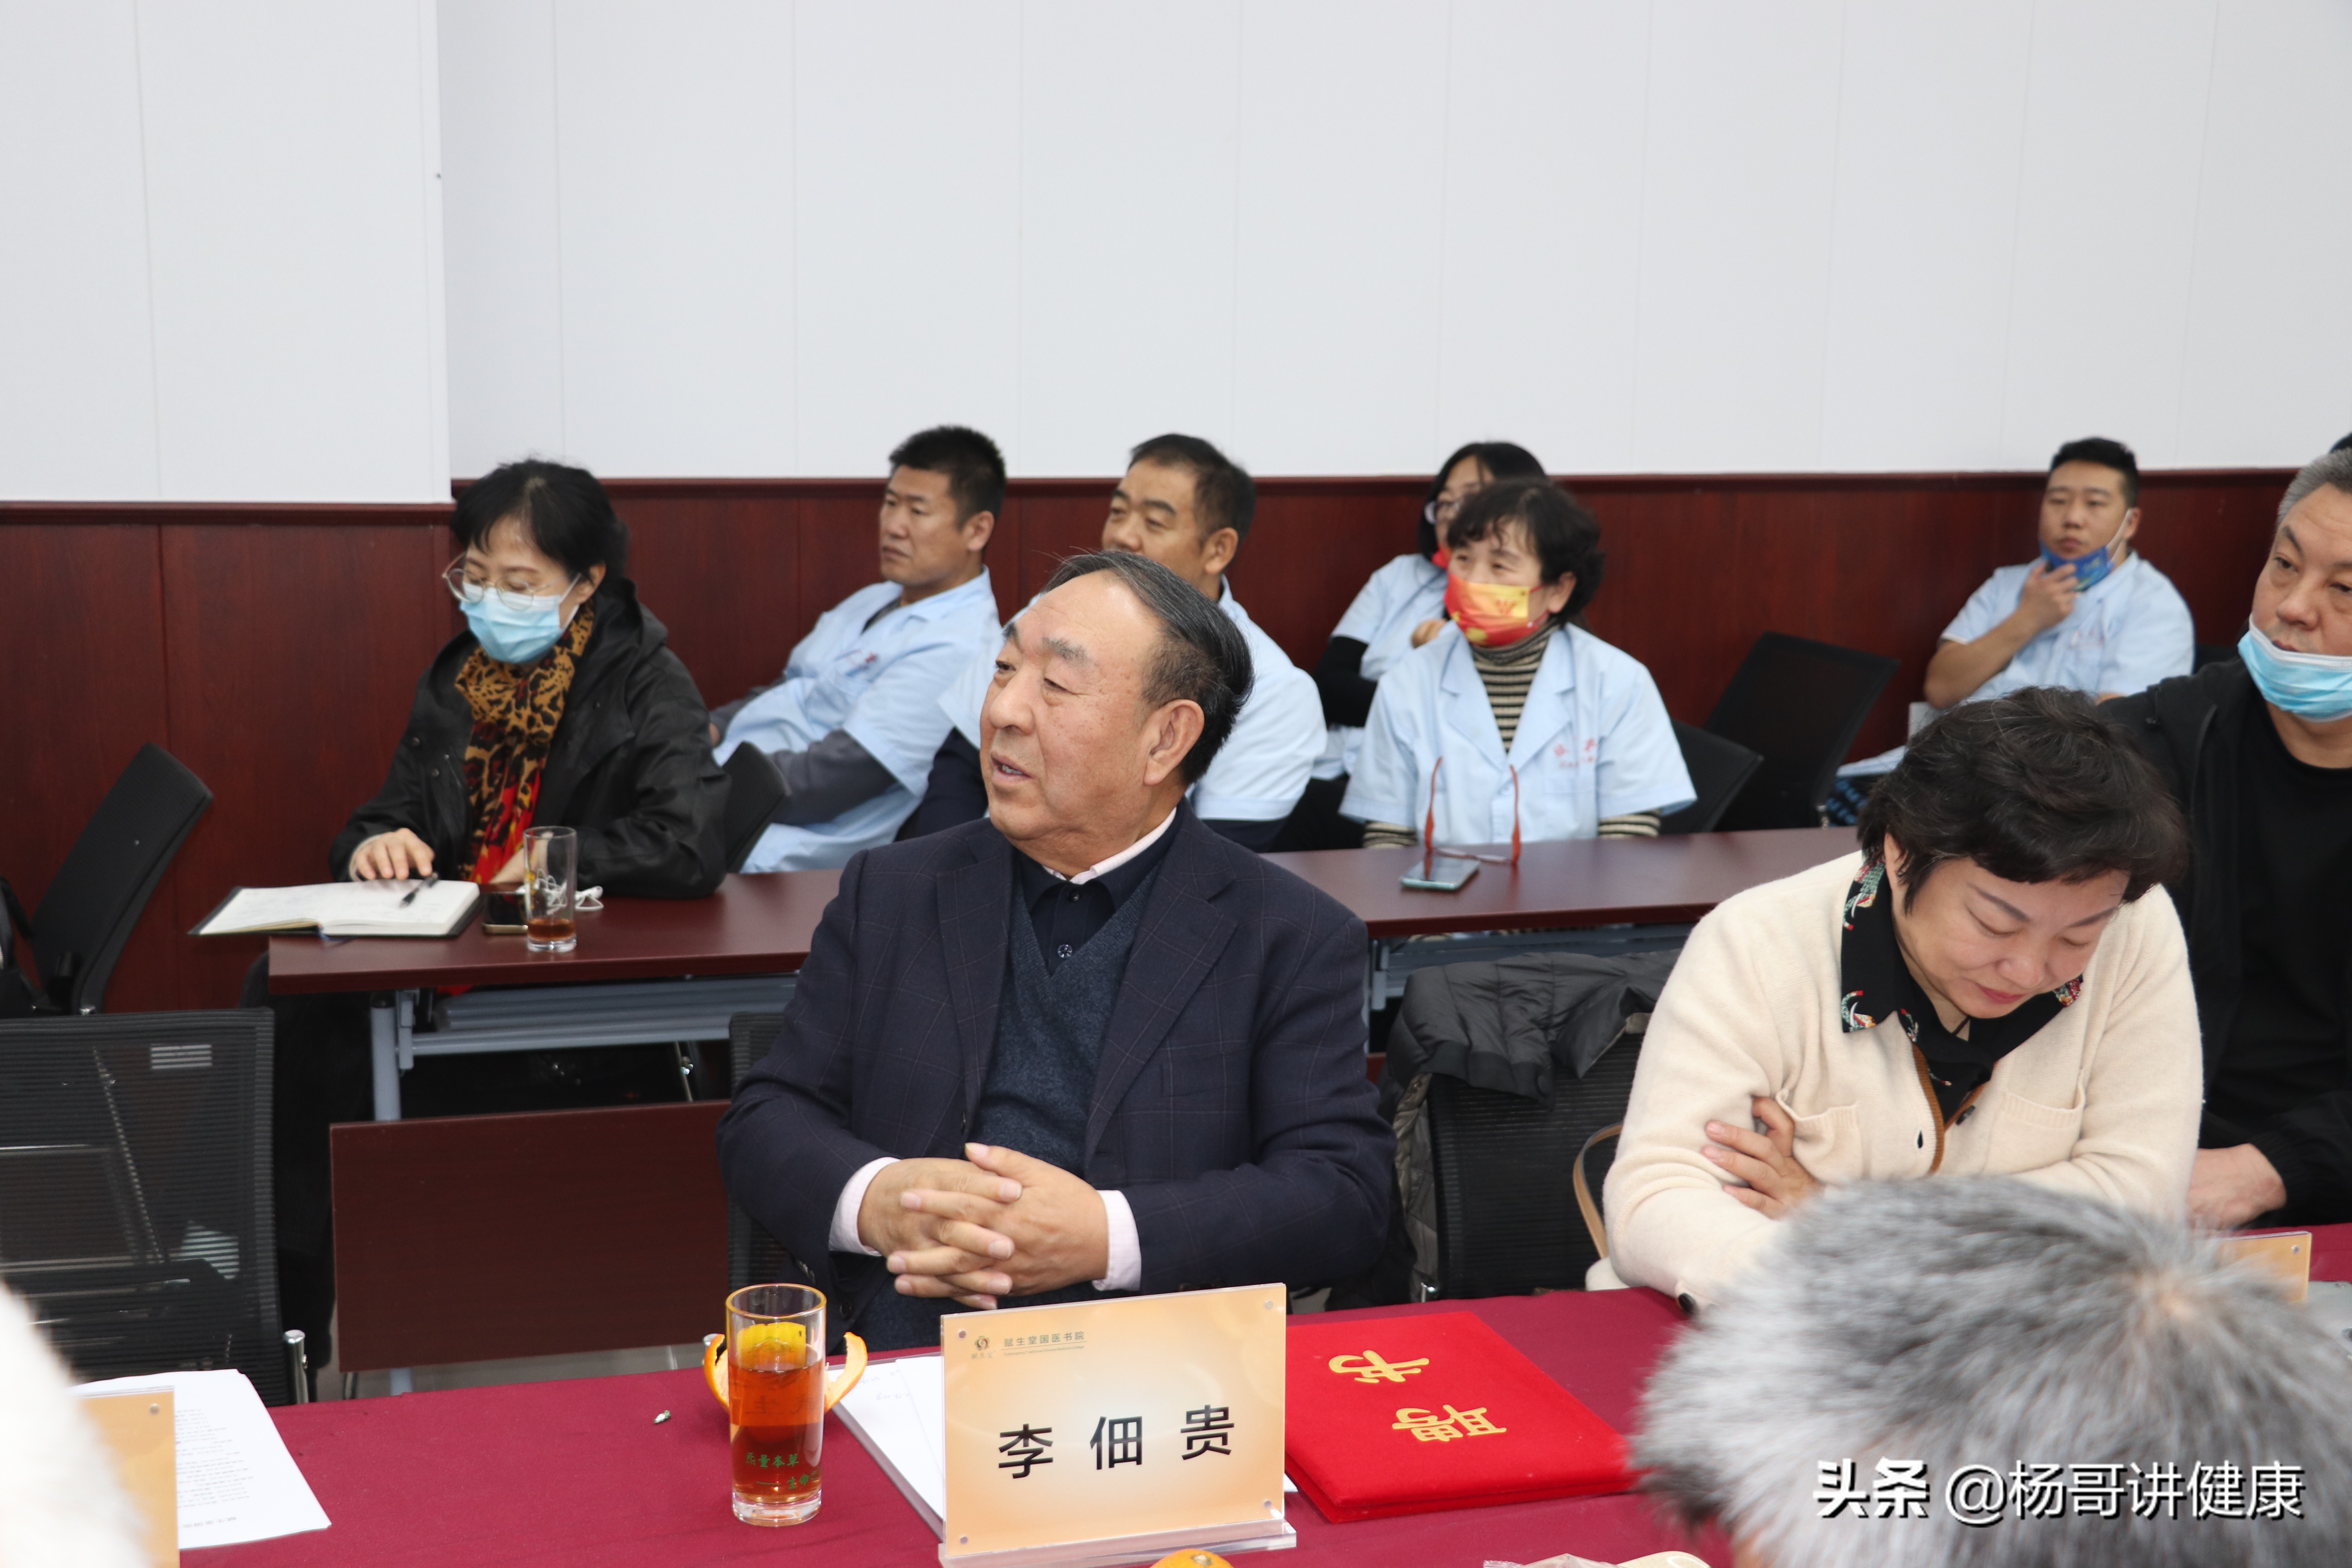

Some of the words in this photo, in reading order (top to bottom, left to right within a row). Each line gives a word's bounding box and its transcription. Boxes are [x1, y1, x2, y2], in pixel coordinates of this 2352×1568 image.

[1004, 1331, 1085, 1347] 赋生堂国医书院
[998, 1404, 1235, 1479] 李佃贵
